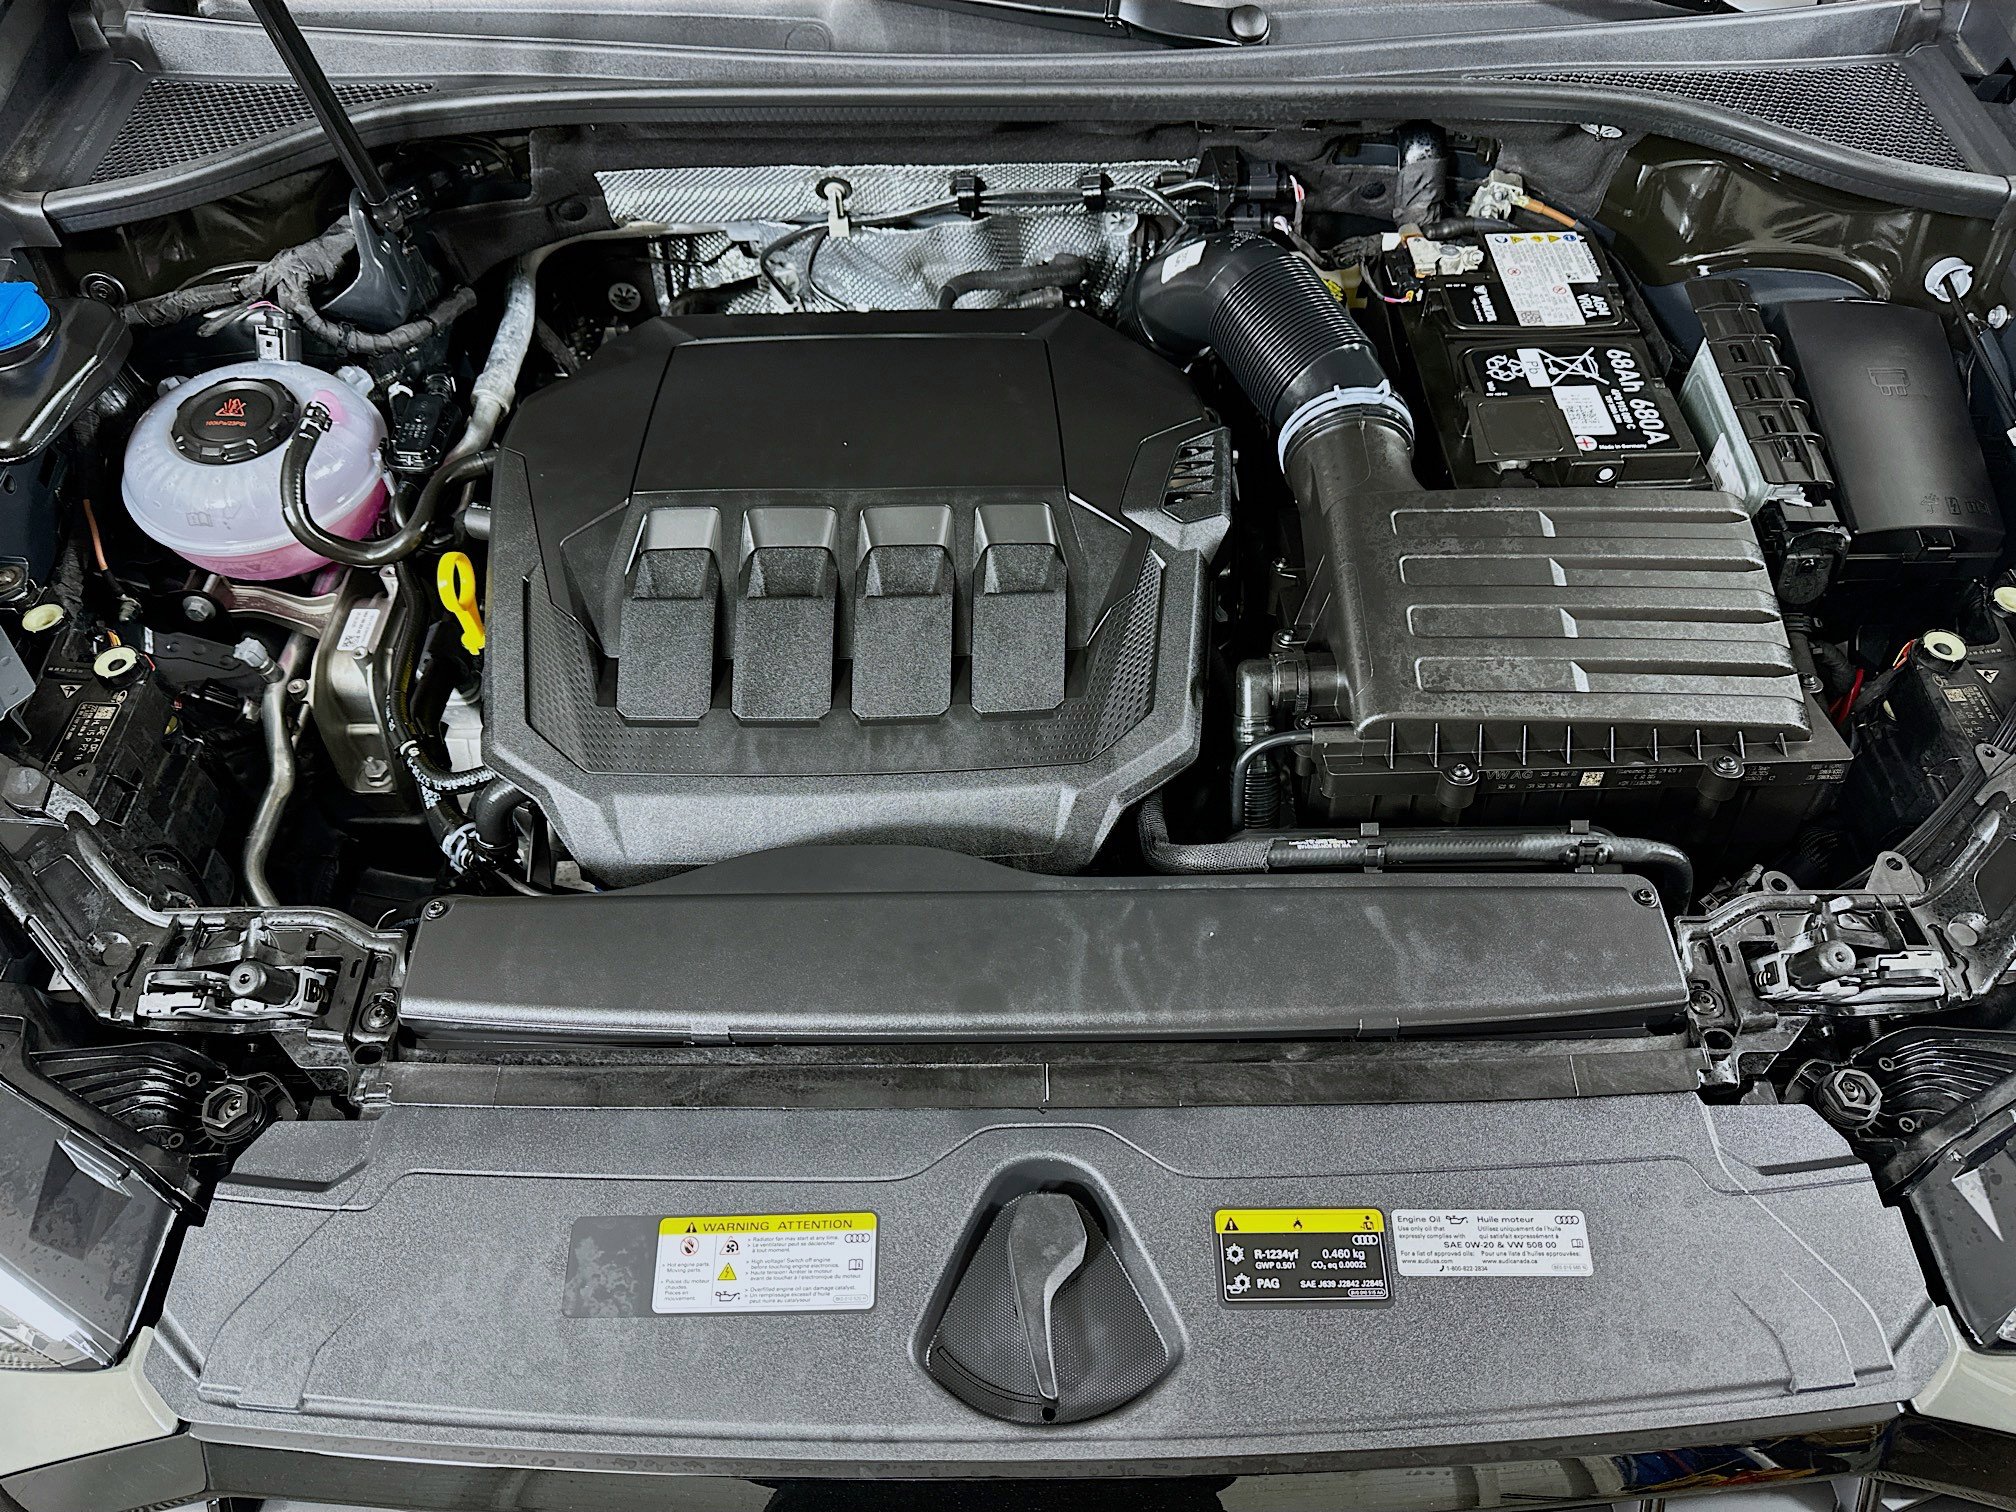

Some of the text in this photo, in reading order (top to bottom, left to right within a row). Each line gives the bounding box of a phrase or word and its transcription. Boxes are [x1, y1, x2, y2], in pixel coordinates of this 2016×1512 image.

[1577, 293, 1597, 318] VRLA
[1591, 295, 1611, 316] AGM
[1526, 361, 1540, 374] Pb
[1606, 349, 1670, 444] 68Ah 680A
[1486, 770, 1510, 779] VW
[1511, 770, 1533, 779] AG
[704, 1220, 852, 1231] WARNING ATTENTION
[1254, 1248, 1365, 1260] R-1234yf 0.460 kg
[1256, 1261, 1295, 1270] GWP 0.501
[1328, 1262, 1338, 1270] eq
[1257, 1278, 1280, 1289] PAG
